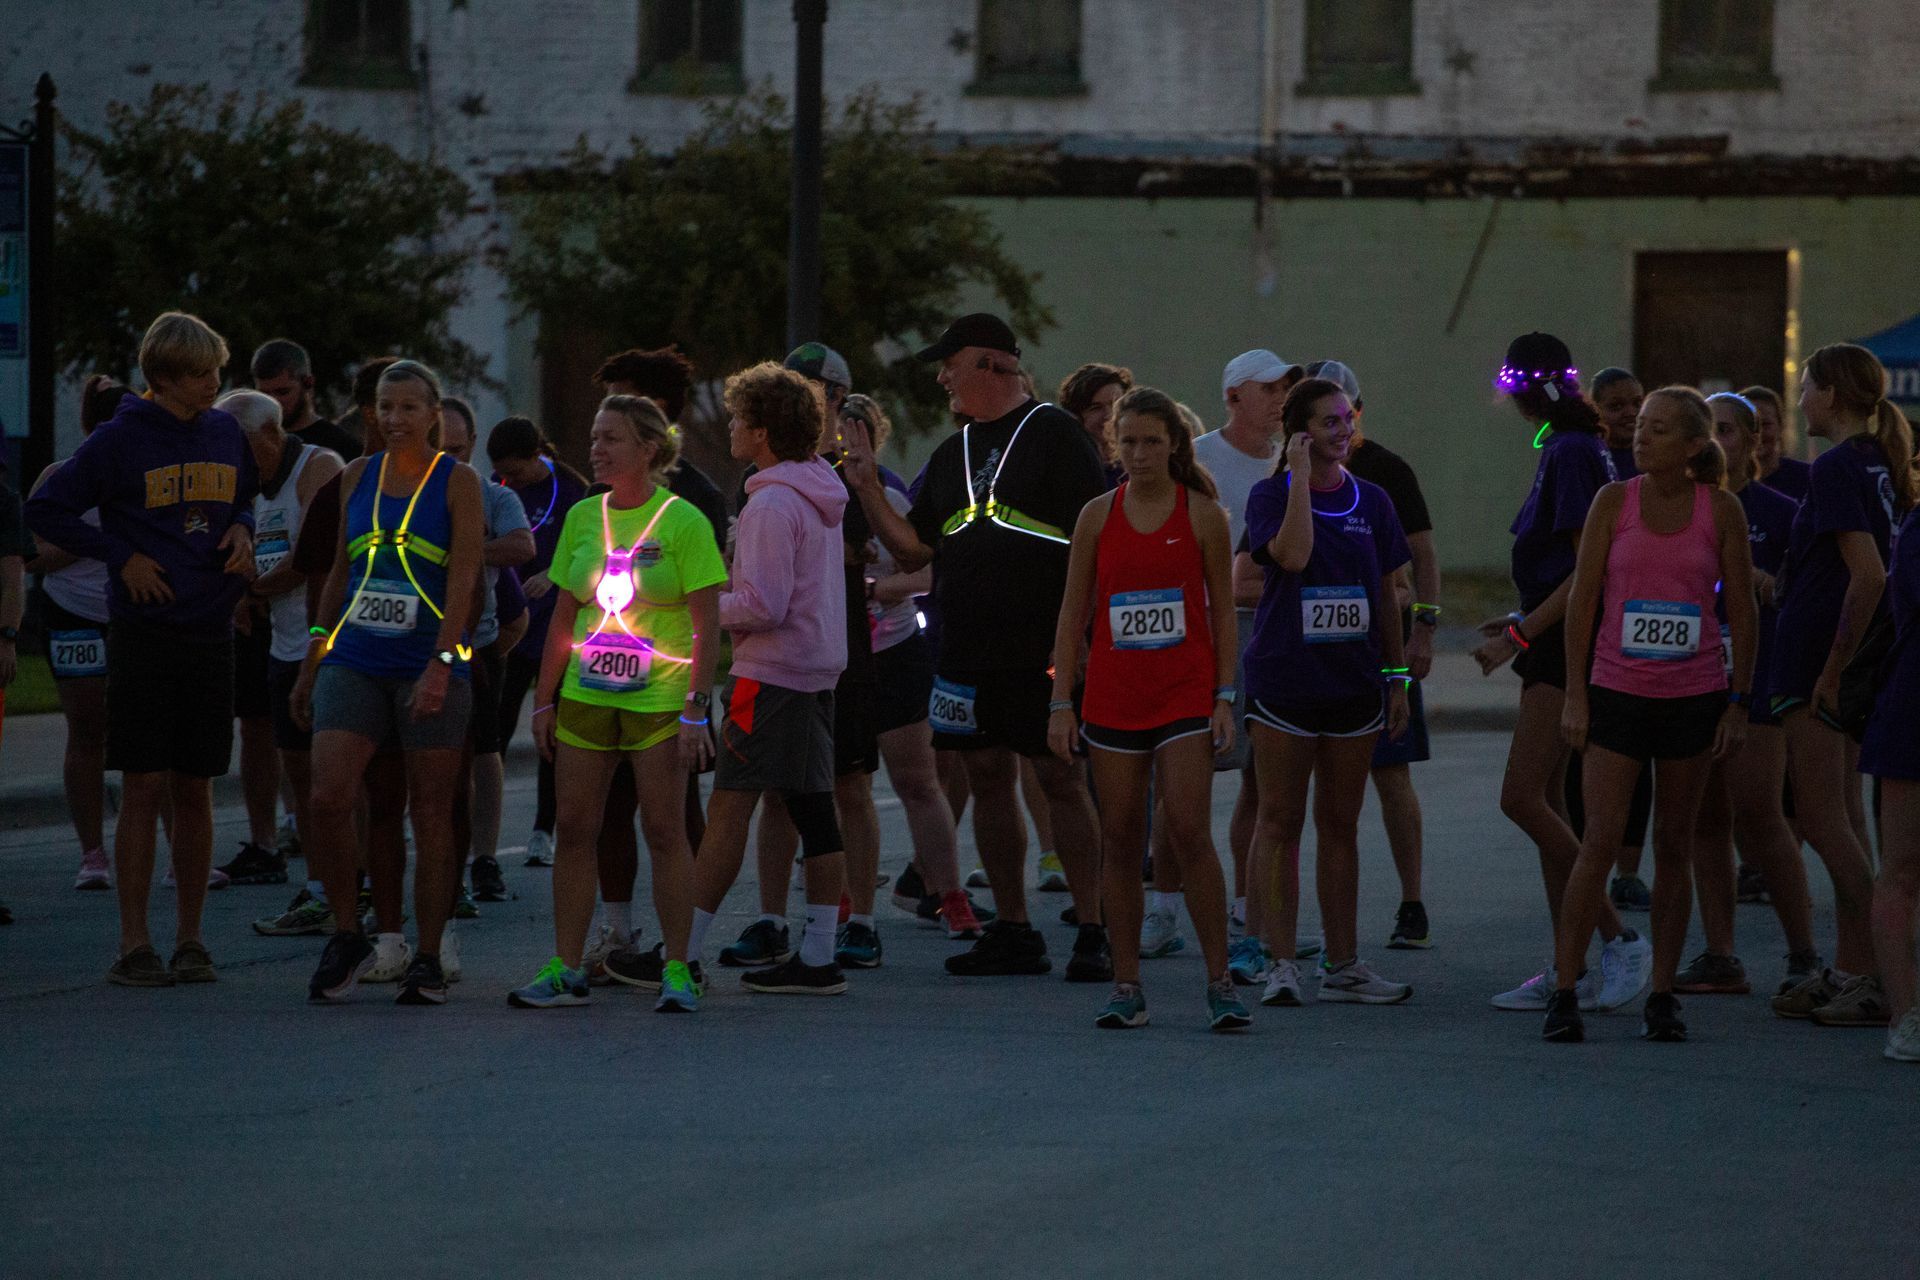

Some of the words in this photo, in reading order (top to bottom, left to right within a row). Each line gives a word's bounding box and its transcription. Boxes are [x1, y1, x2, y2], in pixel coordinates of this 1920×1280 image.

[358, 596, 407, 624] 2808
[1121, 607, 1174, 636] 2820
[1312, 604, 1360, 628] 2768
[1633, 618, 1689, 646] 2828
[57, 644, 97, 665] 2780
[589, 650, 639, 678] 2800
[932, 694, 967, 722] 2805
